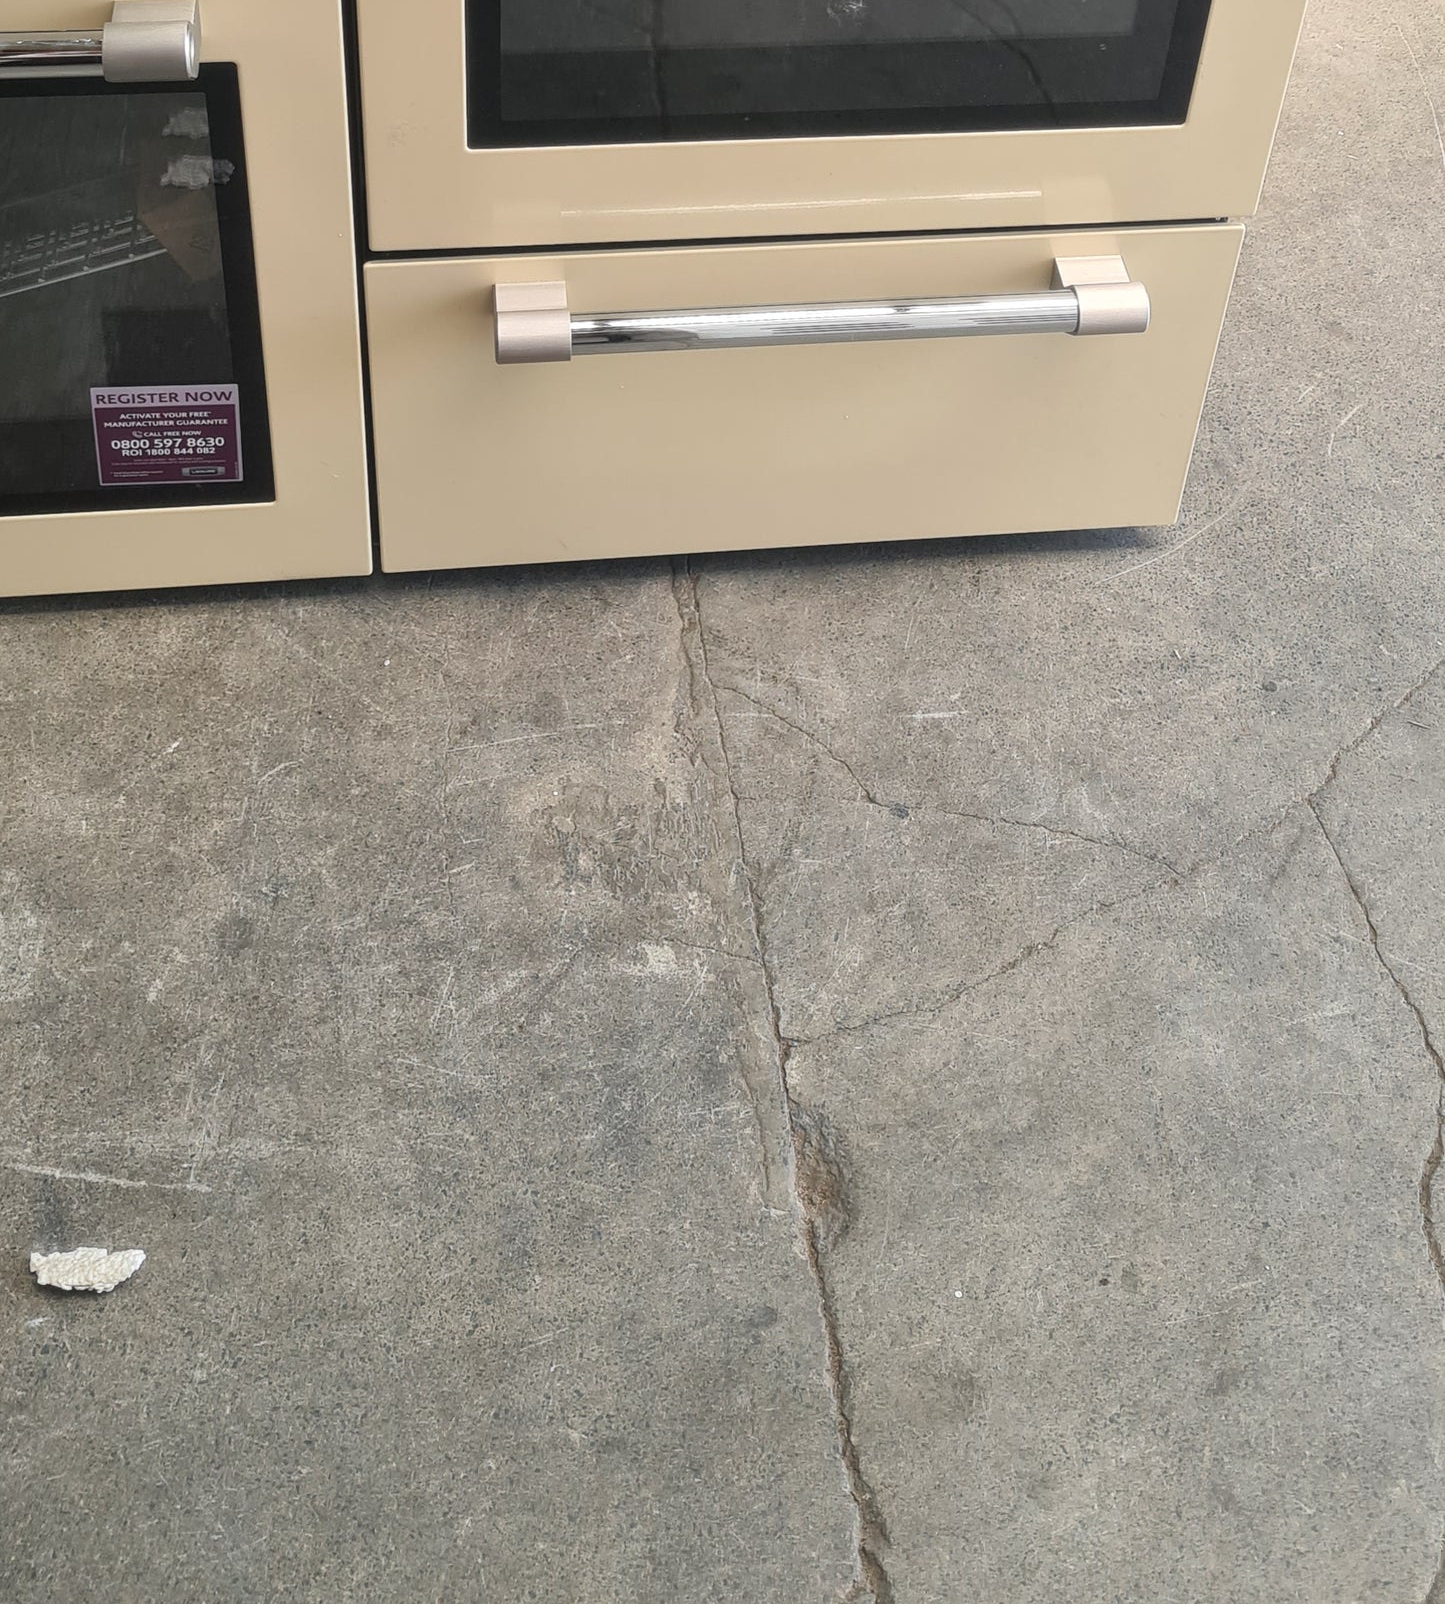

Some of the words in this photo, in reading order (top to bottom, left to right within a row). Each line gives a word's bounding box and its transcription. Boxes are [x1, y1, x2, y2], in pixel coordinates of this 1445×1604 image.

[95, 392, 179, 405] REGISTER
[185, 391, 233, 402] NOW
[103, 420, 175, 428] MANUFACTURER
[176, 418, 228, 426] GUARANTEE
[111, 439, 150, 450] 0800
[153, 438, 182, 448] 597
[187, 437, 225, 447] 8630
[121, 449, 143, 457] ROI
